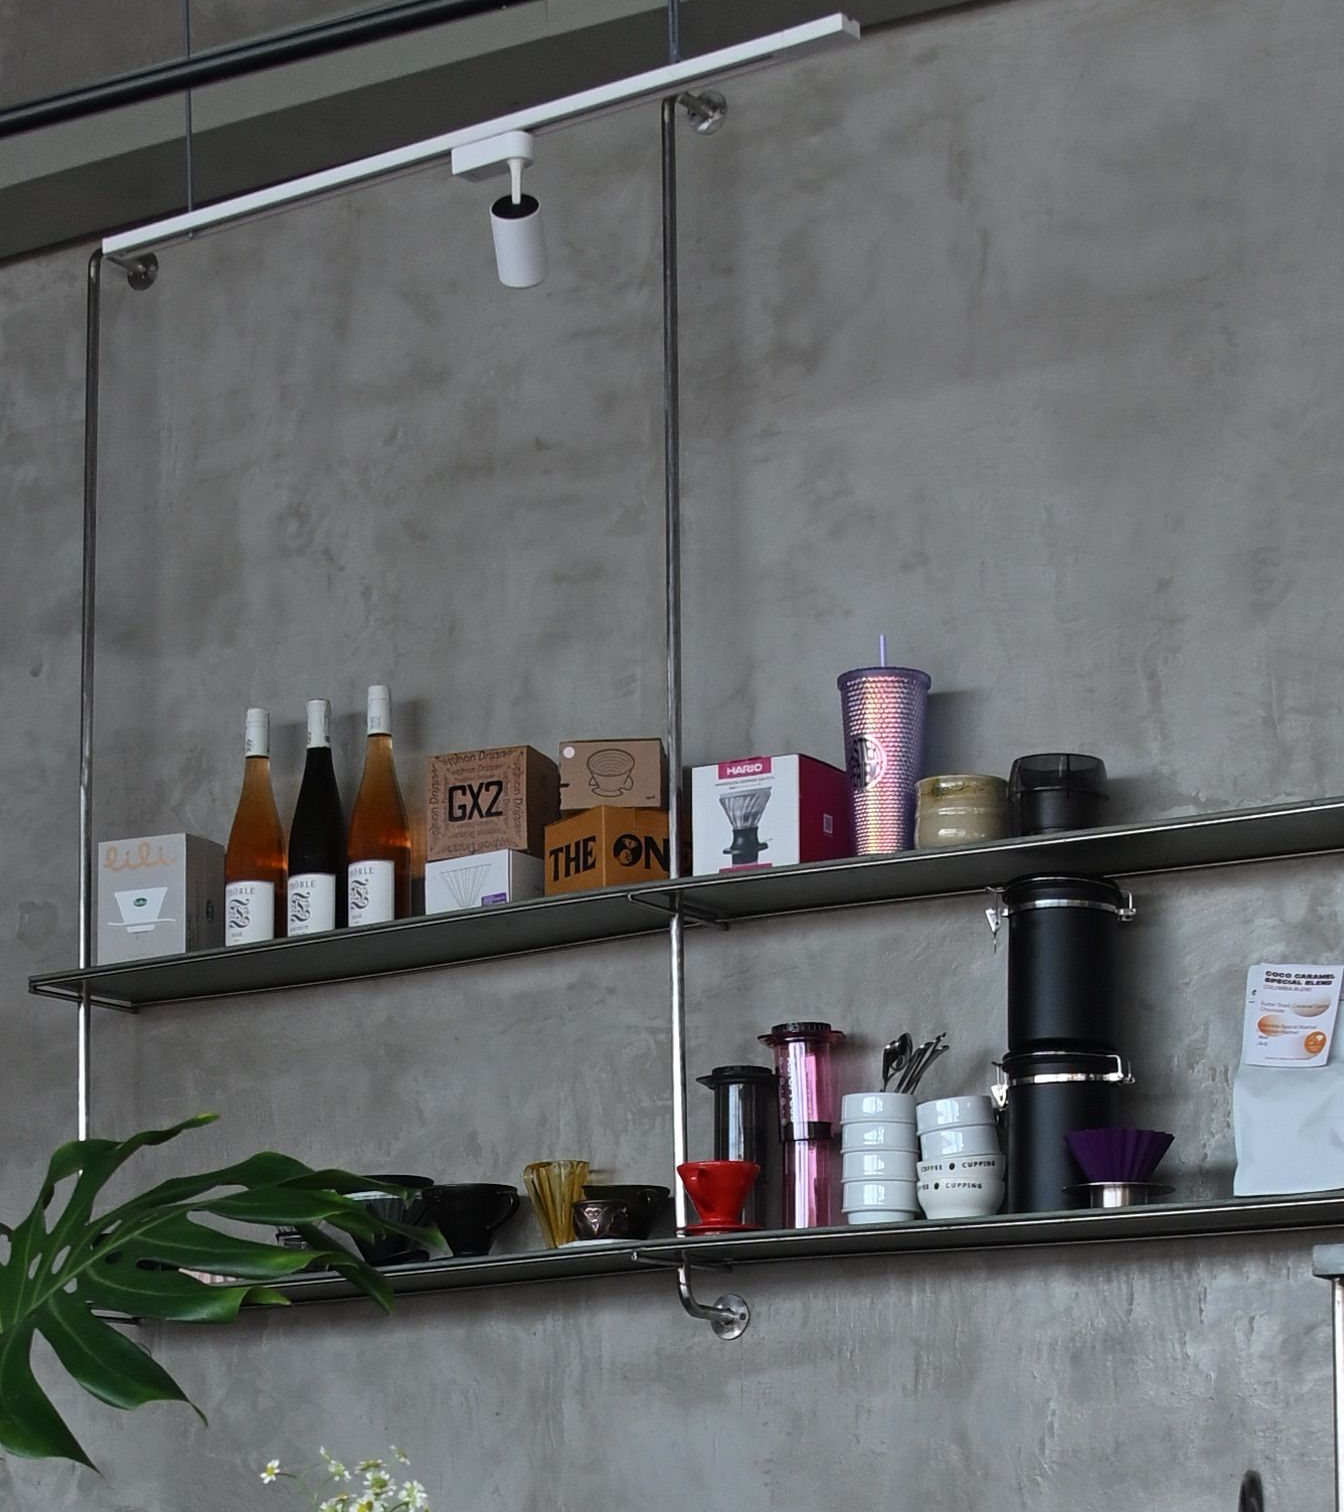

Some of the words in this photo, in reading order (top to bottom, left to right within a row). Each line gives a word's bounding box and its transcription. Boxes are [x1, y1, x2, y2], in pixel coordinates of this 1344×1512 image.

[726, 762, 763, 776] HARIO
[447, 780, 503, 822] GX2
[549, 835, 597, 882] THE
[613, 833, 670, 873] ON
[1264, 970, 1292, 979] COCO
[1294, 972, 1336, 980] CARAMEL
[1263, 977, 1302, 986] SPECIAL
[961, 1160, 996, 1169] CUPPING
[945, 1182, 983, 1190] CUPPING
